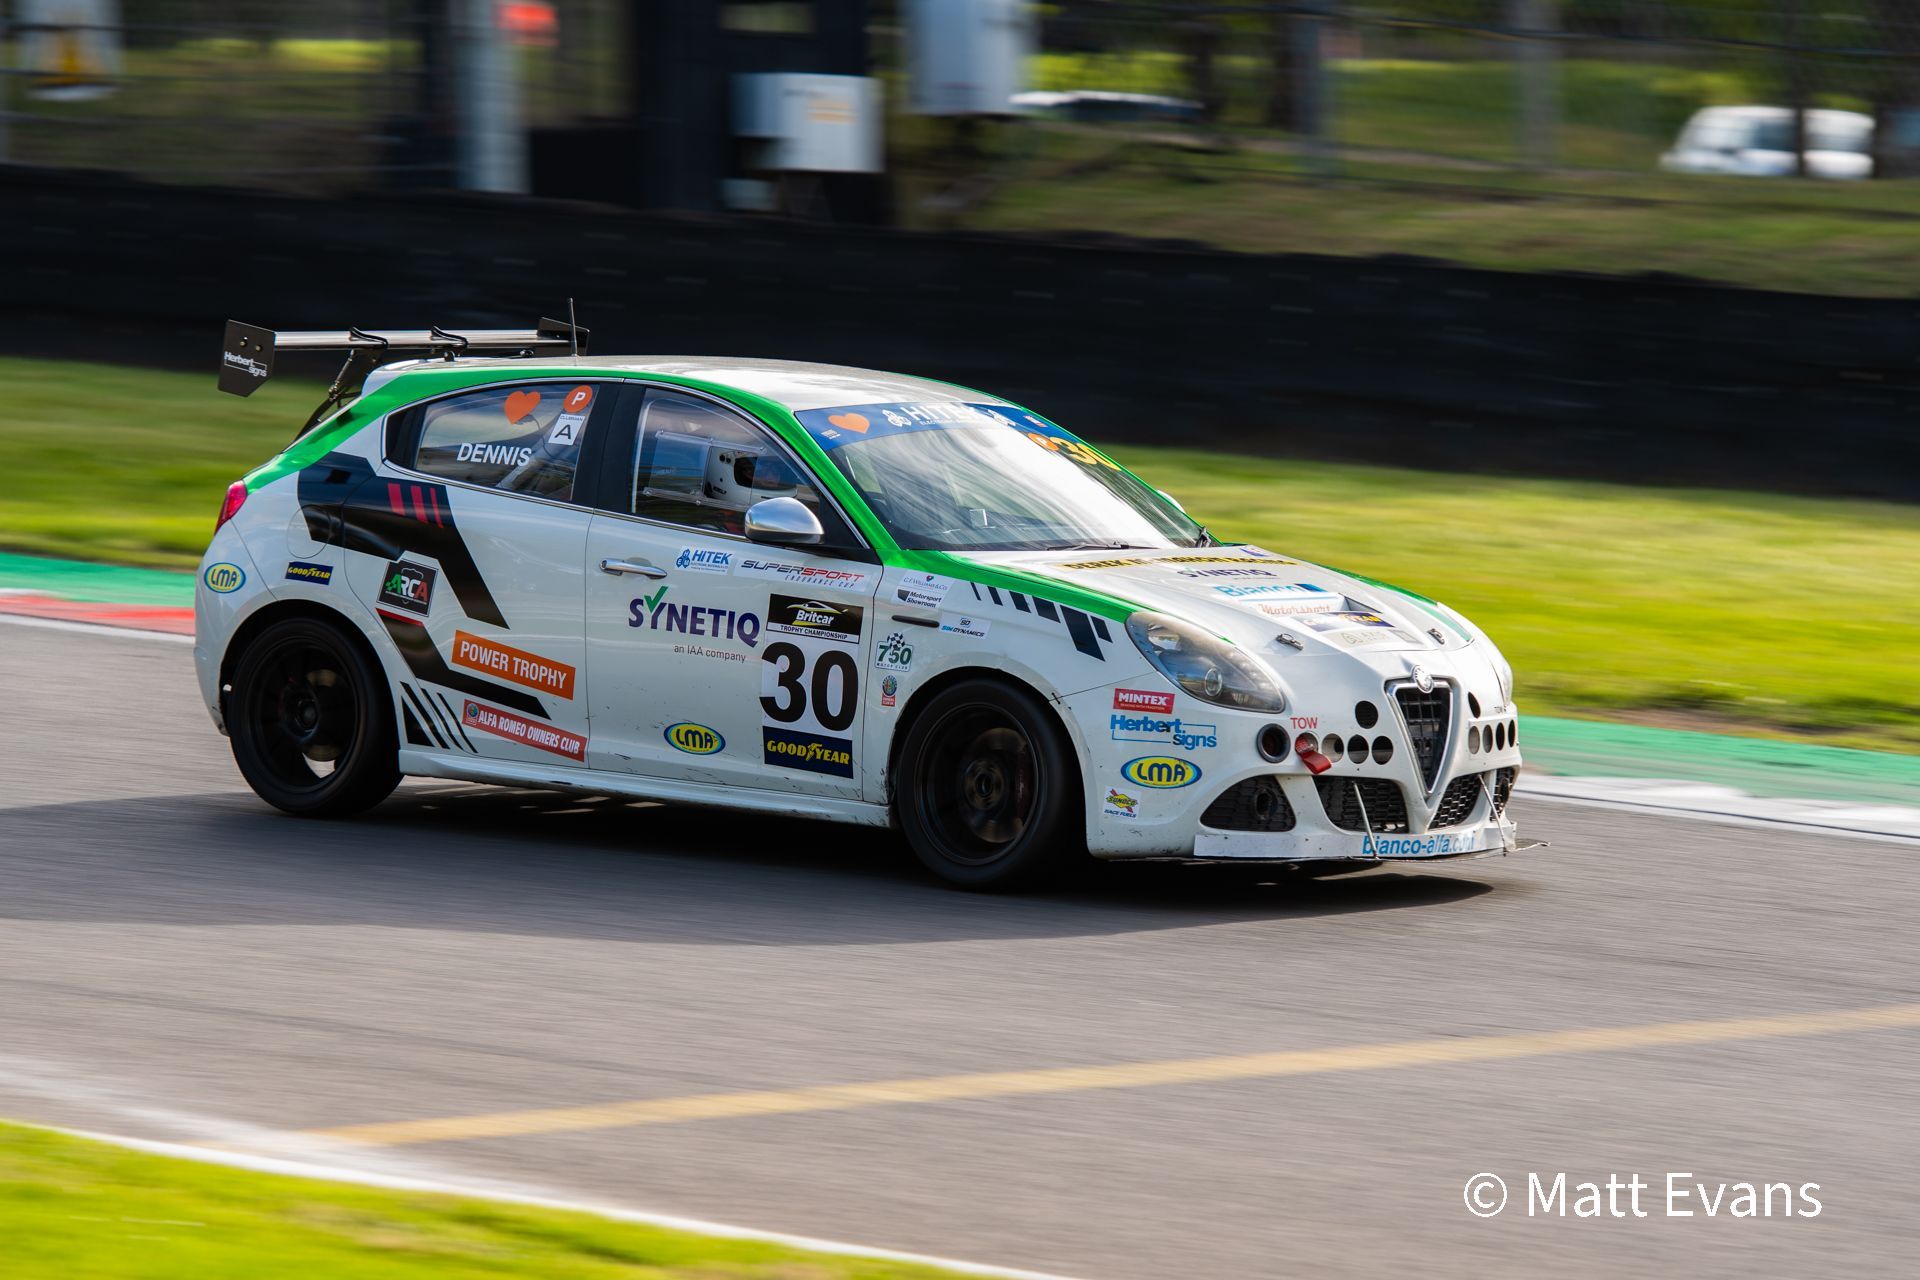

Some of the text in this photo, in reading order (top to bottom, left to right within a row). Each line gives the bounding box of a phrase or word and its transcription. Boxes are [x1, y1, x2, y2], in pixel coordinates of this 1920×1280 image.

[224, 351, 255, 367] Herbert
[571, 391, 587, 406] P
[554, 424, 572, 440] A
[457, 442, 532, 467] DENNIS
[691, 549, 733, 565] HITEK
[211, 568, 238, 587] LMA
[287, 566, 331, 579] GOODYEAR
[741, 559, 864, 582] SUPERSPORT
[386, 573, 428, 602] ARCA
[1215, 584, 1300, 597] Bianco
[906, 597, 937, 608] Showroom
[909, 591, 942, 603] Motorsport
[628, 590, 760, 648] SYNETIQ
[796, 610, 834, 625] Britcar
[780, 624, 848, 640] TROPHY CHAMPIONSHIP
[953, 627, 985, 637] DYNAMICS
[674, 645, 746, 663] an IAA company
[878, 644, 911, 665] 750
[460, 640, 567, 689] POWER TROPHY
[759, 641, 859, 732] 30
[1118, 692, 1167, 706] MINTEX
[478, 710, 497, 727] ALFA
[498, 716, 526, 736] ROMEO
[528, 726, 560, 748] OWNERS
[560, 736, 580, 754] CLUB
[1110, 714, 1183, 734] Herbert
[1290, 717, 1318, 729] TOW
[676, 728, 714, 749] LMA
[1172, 732, 1217, 751] signs
[766, 741, 850, 765] GOODYEAR
[1137, 763, 1186, 782] LMA
